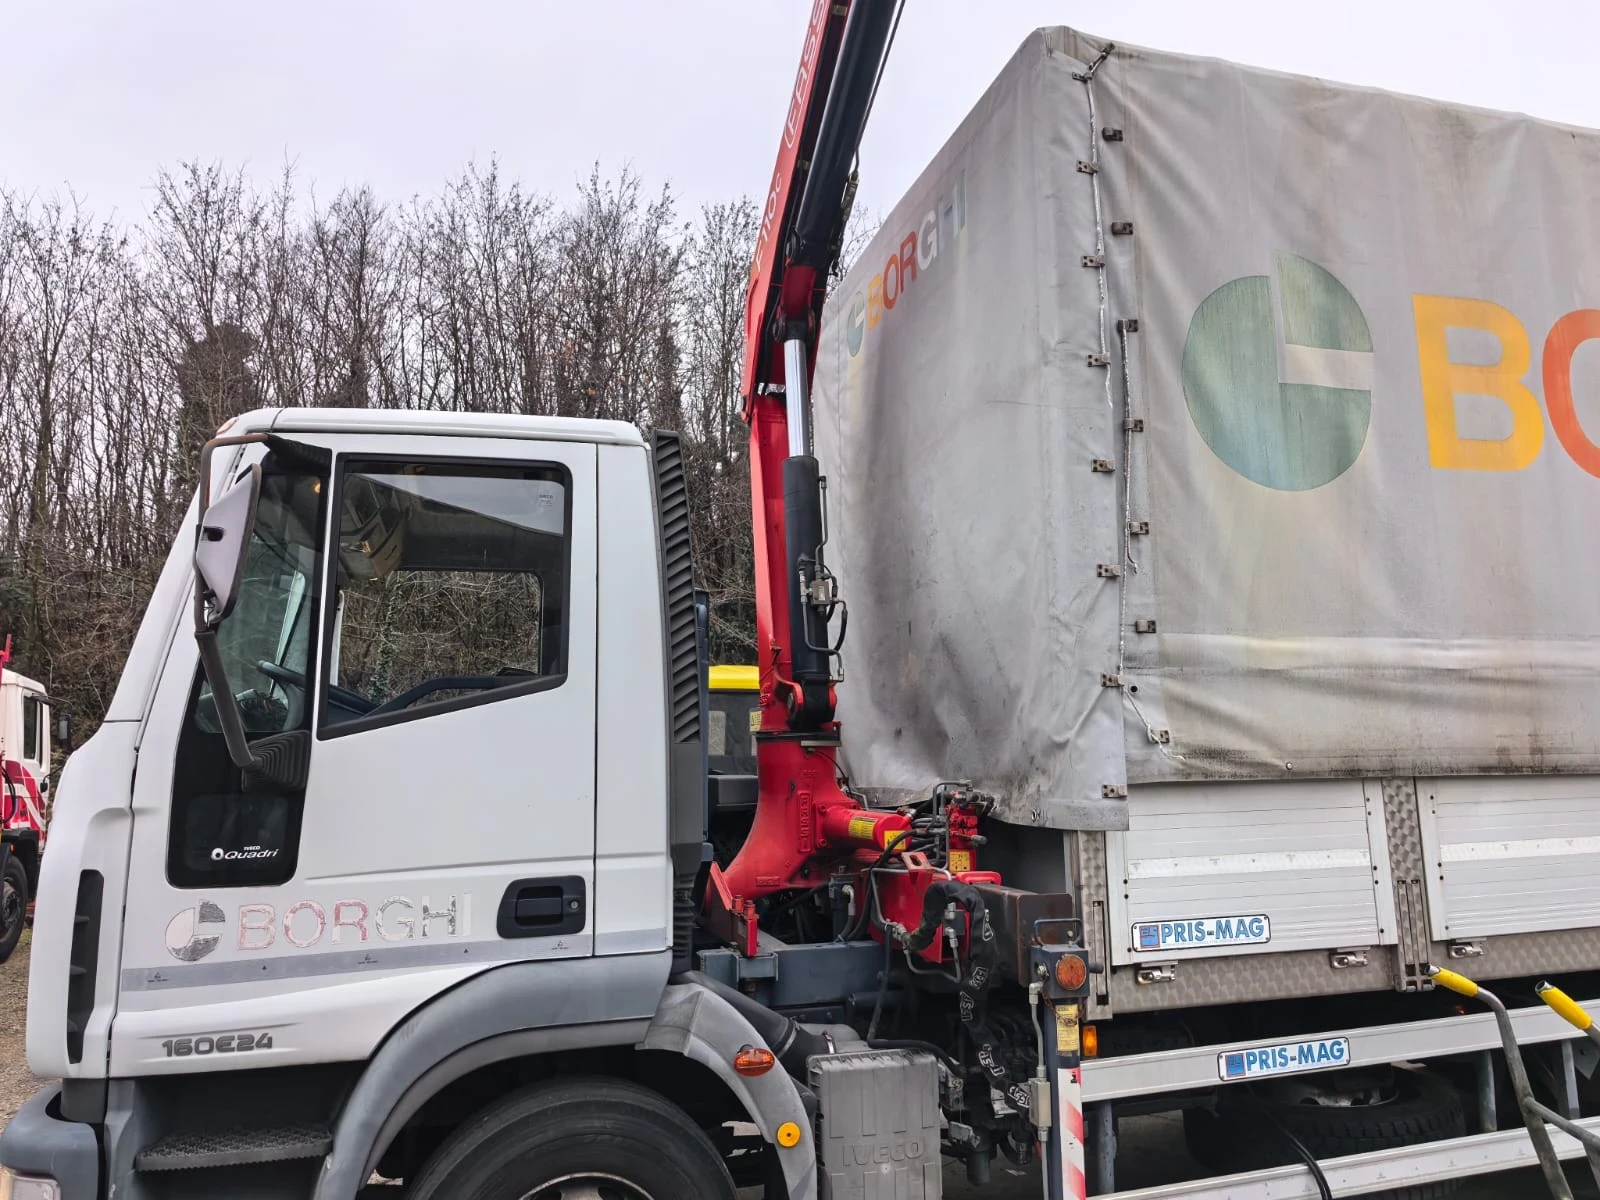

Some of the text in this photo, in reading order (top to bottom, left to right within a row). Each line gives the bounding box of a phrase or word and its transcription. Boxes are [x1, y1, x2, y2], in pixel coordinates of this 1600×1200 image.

[867, 168, 967, 331] BORGHI
[224, 848, 279, 859] Quadri
[239, 893, 471, 949] BORGHI
[1161, 918, 1264, 943] PRIS-MAG
[163, 1033, 273, 1057] 160E24
[1245, 1041, 1344, 1071] PRIS-MAG
[843, 1142, 924, 1167] IVECO
